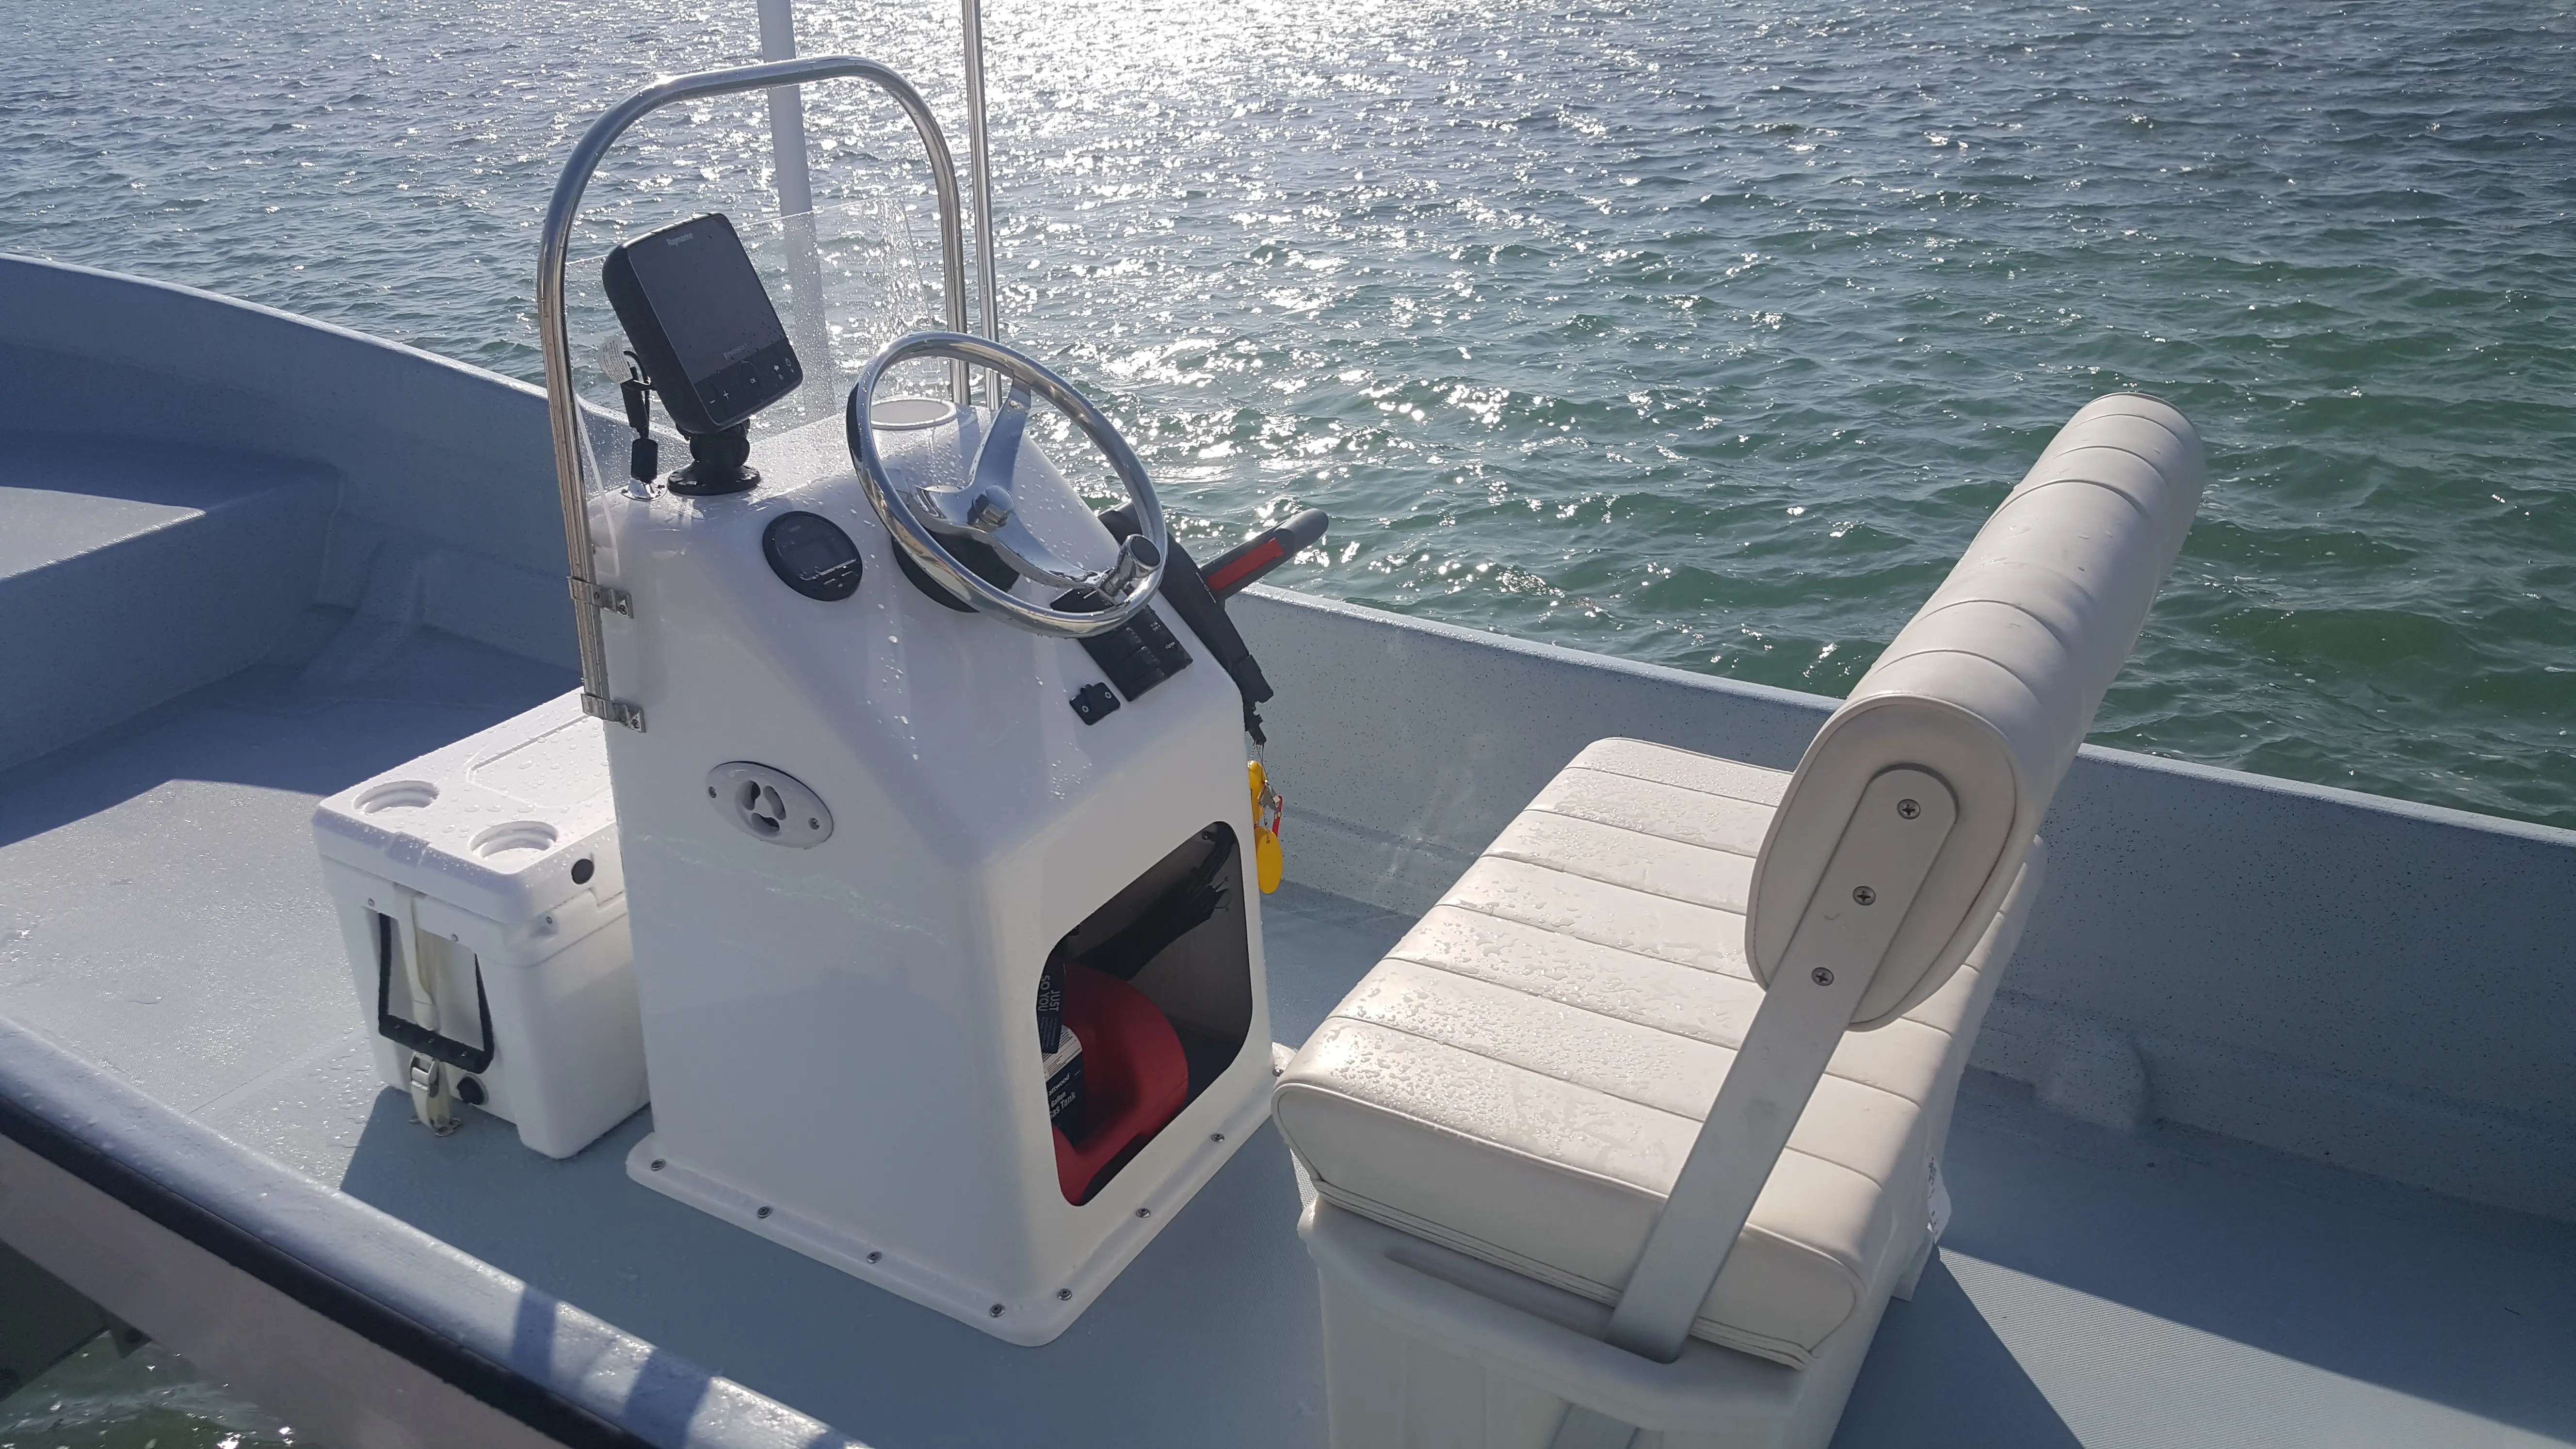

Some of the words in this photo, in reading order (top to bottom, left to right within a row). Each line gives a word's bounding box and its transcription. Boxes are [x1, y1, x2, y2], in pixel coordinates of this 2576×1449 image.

[666, 233, 693, 246] Raymarine
[1040, 975, 1050, 990] SO
[1038, 991, 1050, 1011] YOU
[1049, 989, 1061, 1012] JUST
[1051, 1092, 1066, 1108] Gallon
[1060, 1092, 1076, 1109] Tank
